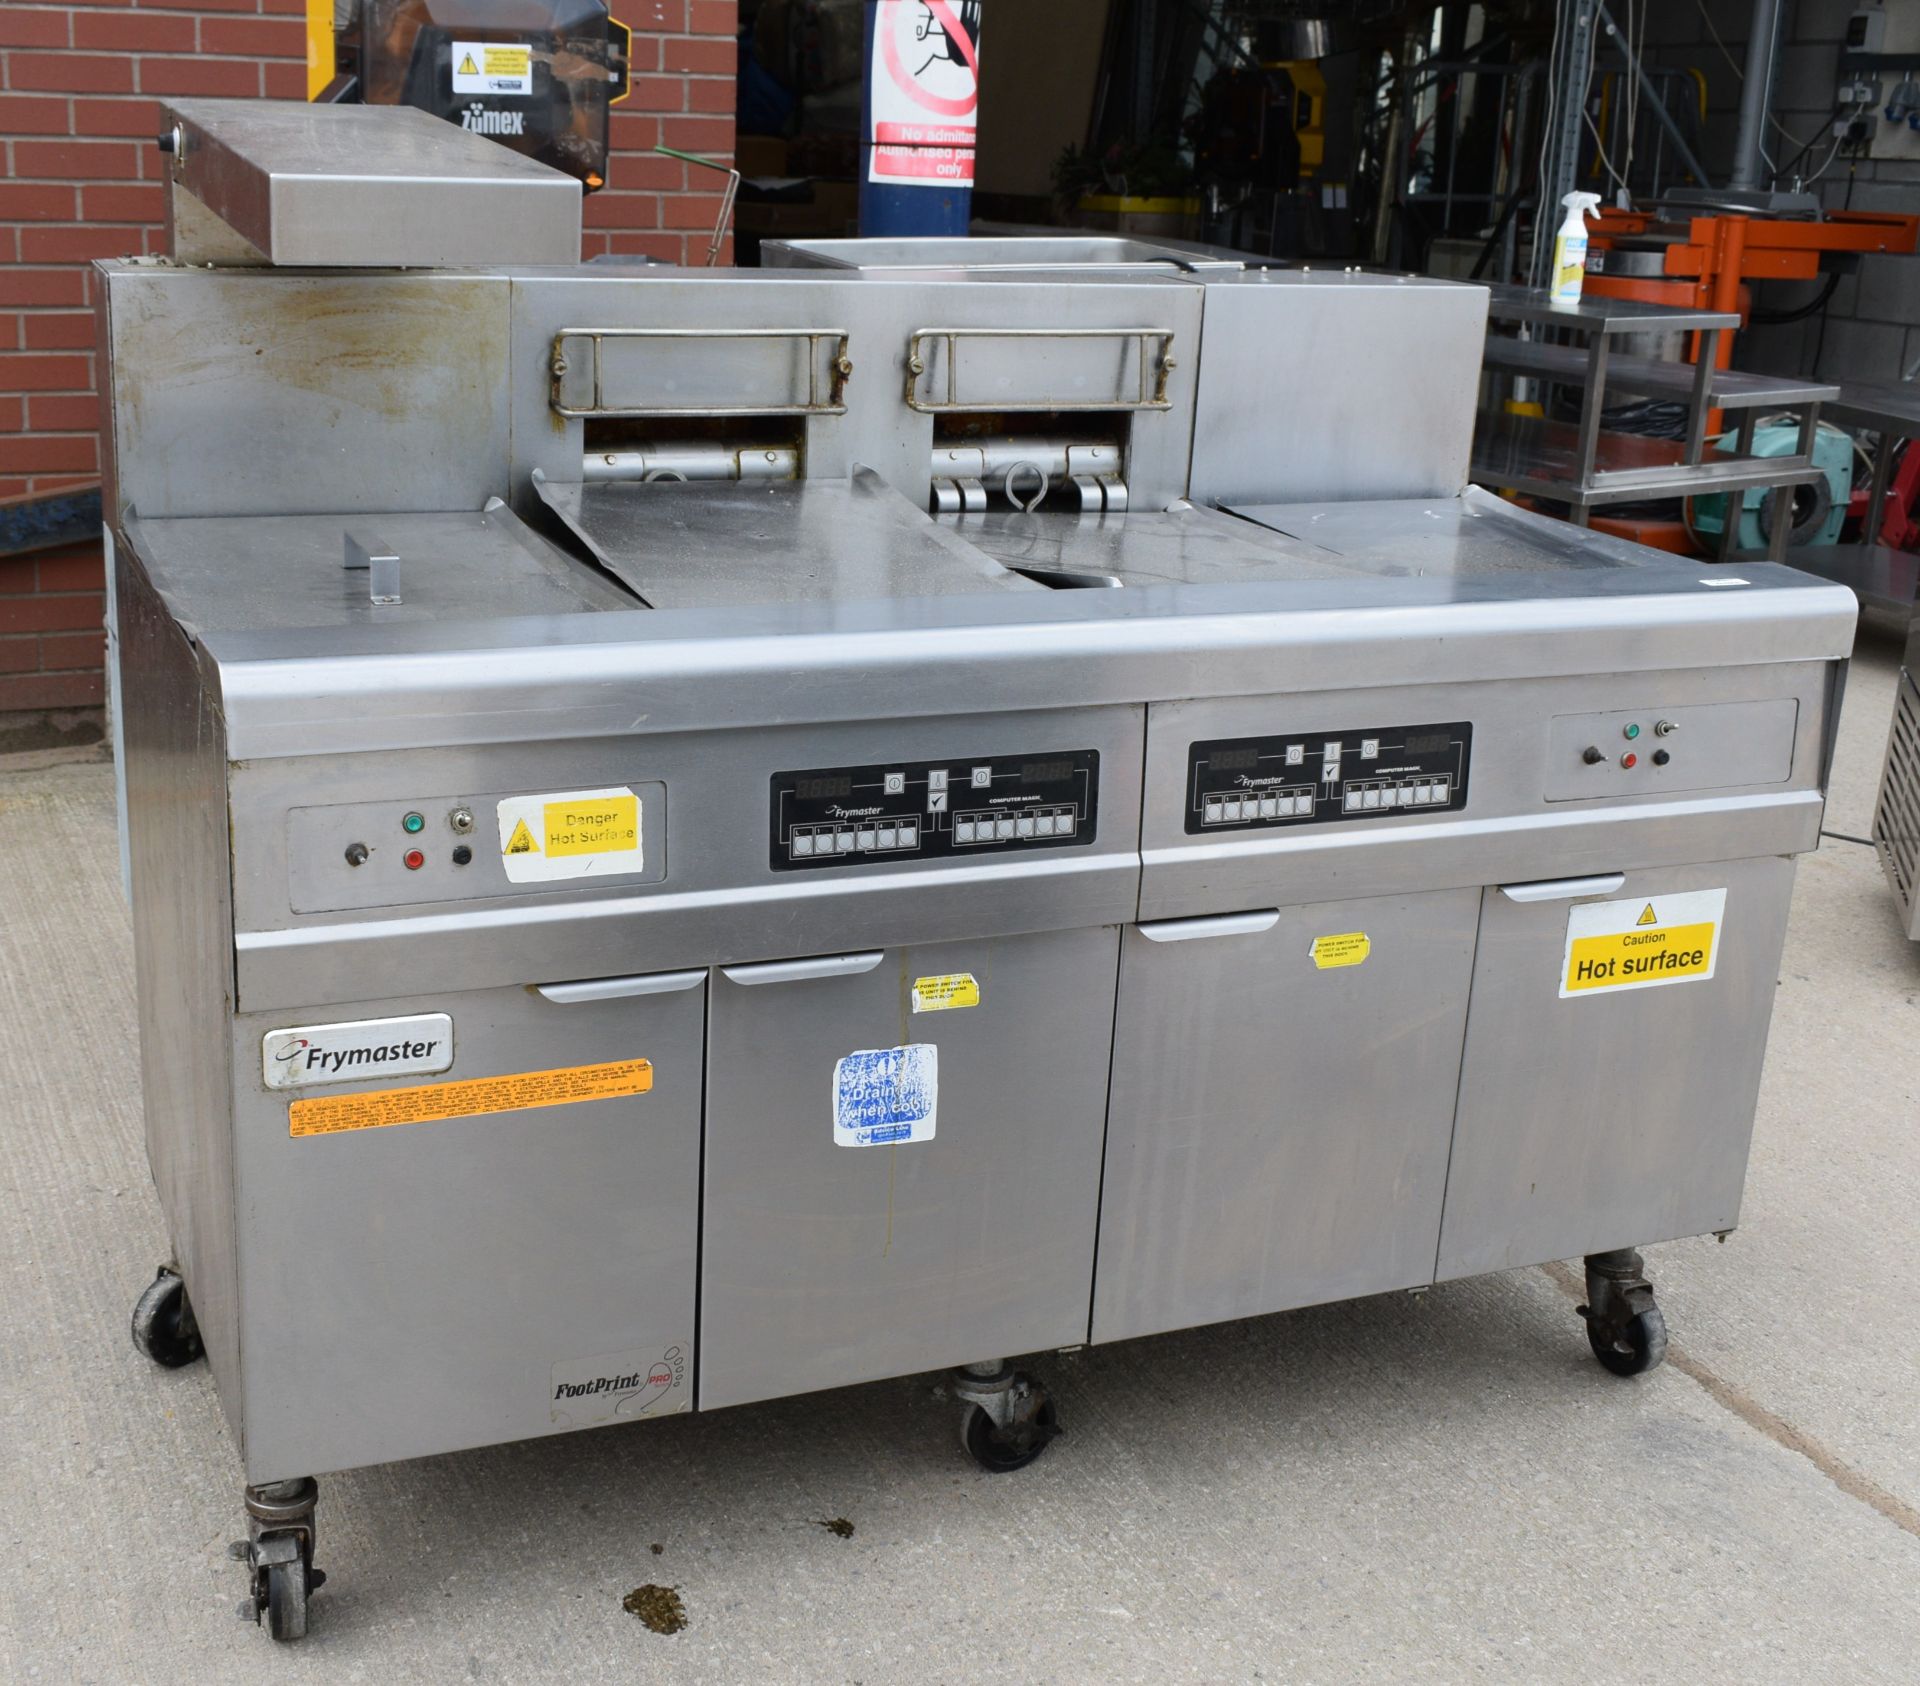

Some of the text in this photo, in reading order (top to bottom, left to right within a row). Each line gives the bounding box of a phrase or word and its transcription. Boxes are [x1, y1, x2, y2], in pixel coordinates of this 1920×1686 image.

[902, 128, 922, 141] No
[936, 162, 962, 178] only
[1242, 776, 1283, 788] Frymaster
[566, 813, 618, 827] Danger
[835, 806, 881, 819] Frymaster
[550, 832, 575, 845] Hot
[1622, 932, 1666, 947] Caution
[1577, 950, 1704, 981] Hot surface
[306, 1040, 437, 1073] Frymaster
[852, 1085, 895, 1101] Drain
[848, 1104, 886, 1119] when
[554, 1372, 640, 1400] FootPrint
[649, 1373, 671, 1384] PRO
